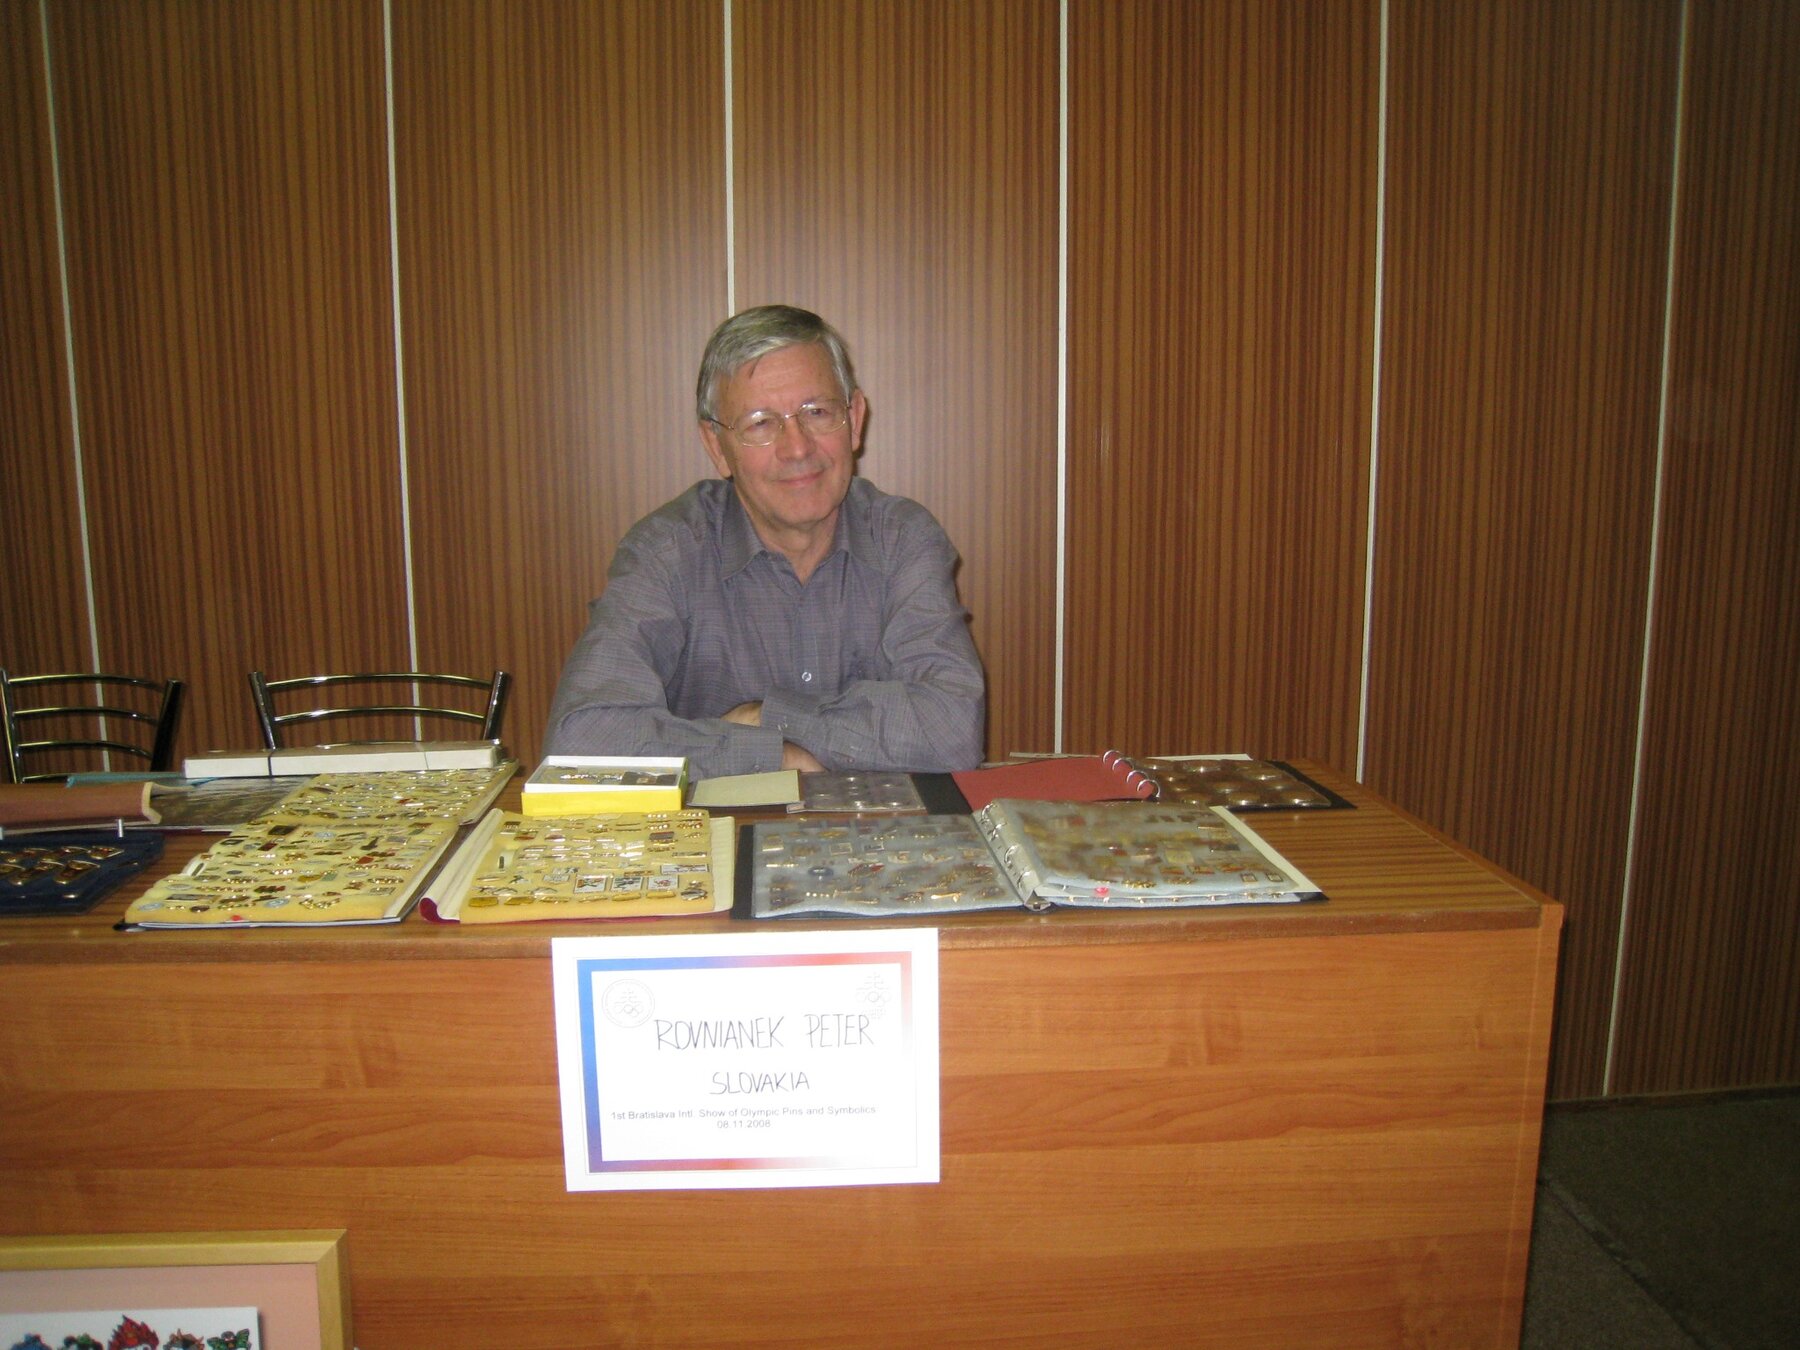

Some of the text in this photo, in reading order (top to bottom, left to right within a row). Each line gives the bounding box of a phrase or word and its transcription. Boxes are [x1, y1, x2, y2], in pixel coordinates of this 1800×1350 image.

[654, 1013, 875, 1051] ROVNIANEK PETER
[709, 1071, 811, 1095] SLOVAKIA
[610, 1111, 626, 1120] 1st
[628, 1109, 676, 1120] Bratislava
[698, 1108, 725, 1118] Show
[728, 1108, 738, 1118] of
[740, 1107, 780, 1119] Olympic
[782, 1107, 804, 1117] Pins
[806, 1106, 824, 1116] and
[827, 1105, 876, 1117] Symbolics
[716, 1119, 772, 1130] 08.11.2008
